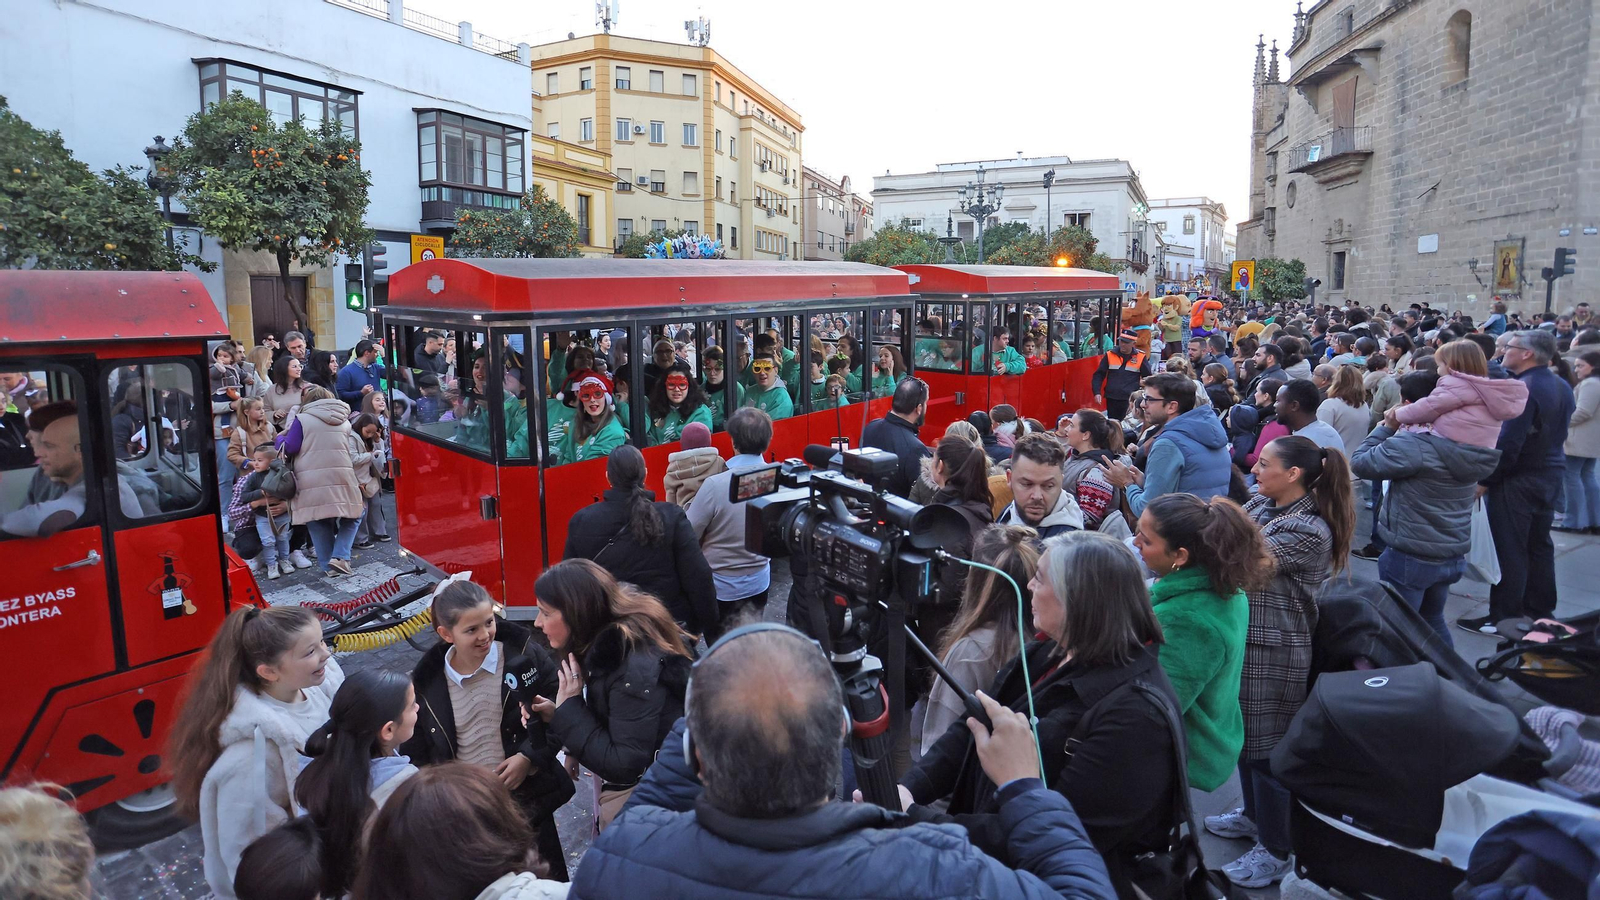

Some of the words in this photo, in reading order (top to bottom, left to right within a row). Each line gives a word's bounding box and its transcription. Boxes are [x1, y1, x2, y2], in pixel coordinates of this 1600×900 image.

[859, 538, 877, 548] SONY
[24, 587, 76, 607] BYASS
[521, 667, 537, 680] Onda
